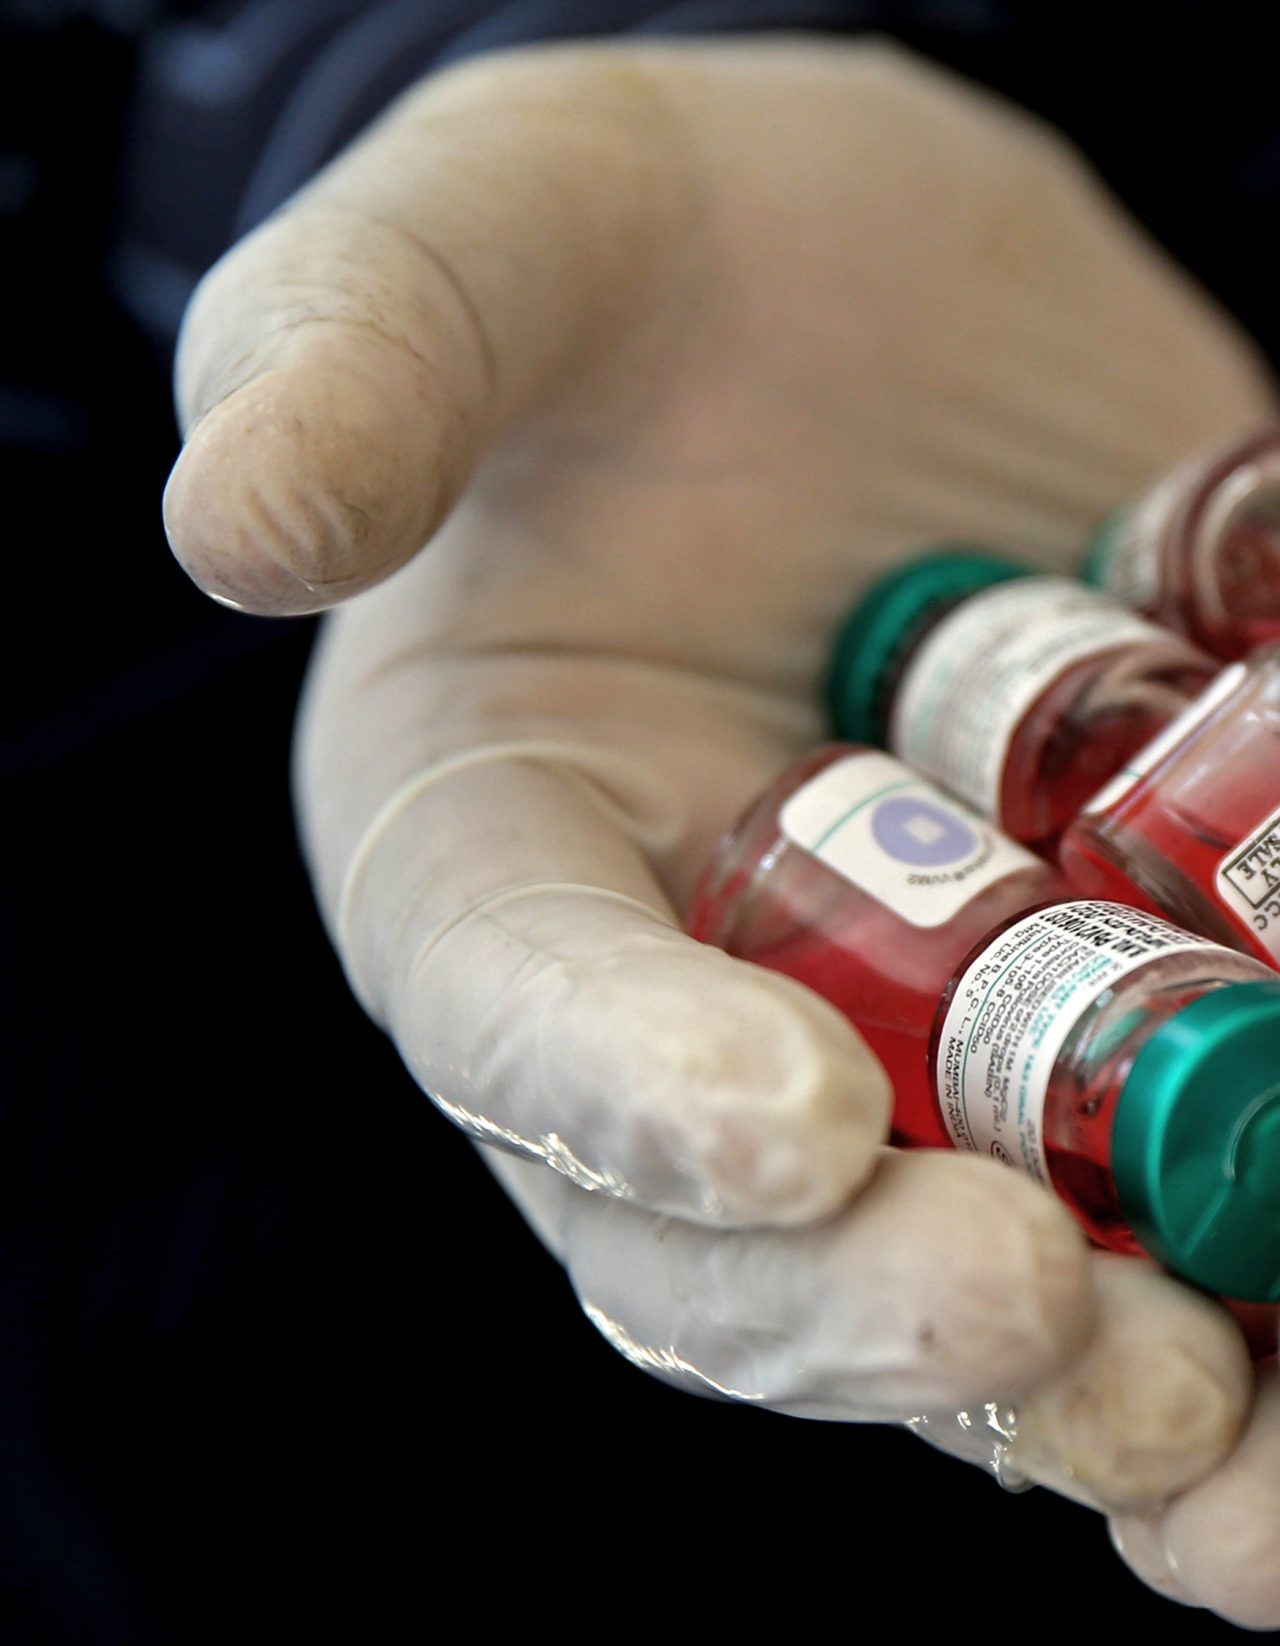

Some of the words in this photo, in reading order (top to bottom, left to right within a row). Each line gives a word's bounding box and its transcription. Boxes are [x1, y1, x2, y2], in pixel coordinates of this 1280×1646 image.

[990, 942, 1012, 961] Lic.
[1033, 933, 1064, 953] Type
[1042, 938, 1073, 958] Type
[971, 963, 991, 985] No.
[965, 988, 974, 998] 5
[946, 1036, 957, 1078] MADE
[945, 1083, 953, 1100] IN
